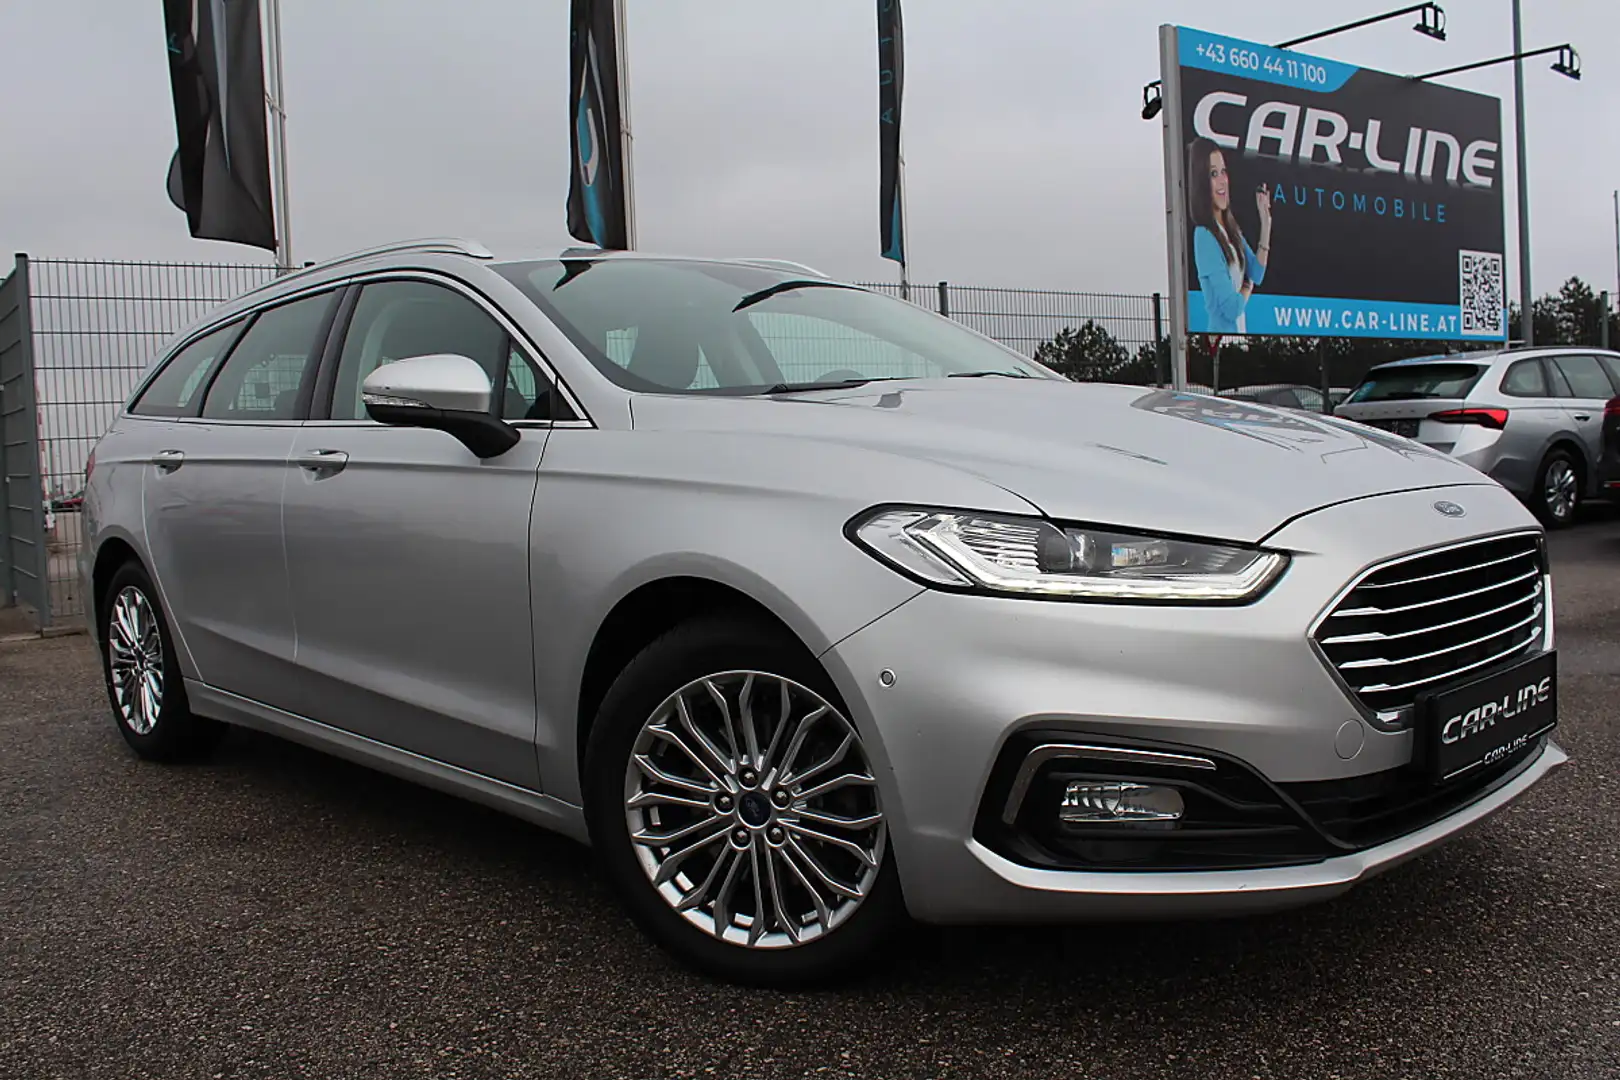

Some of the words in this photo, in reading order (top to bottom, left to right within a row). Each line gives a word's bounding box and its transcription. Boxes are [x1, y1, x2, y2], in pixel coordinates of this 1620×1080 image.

[1195, 42, 1226, 64] +43
[1229, 47, 1260, 71] 660
[1263, 55, 1284, 77] 44
[1286, 59, 1299, 79] 11
[1301, 63, 1326, 84] 100
[1273, 183, 1446, 223] AUTOMOBILE
[1274, 306, 1457, 333] WWW.CAR-LINE.AT
